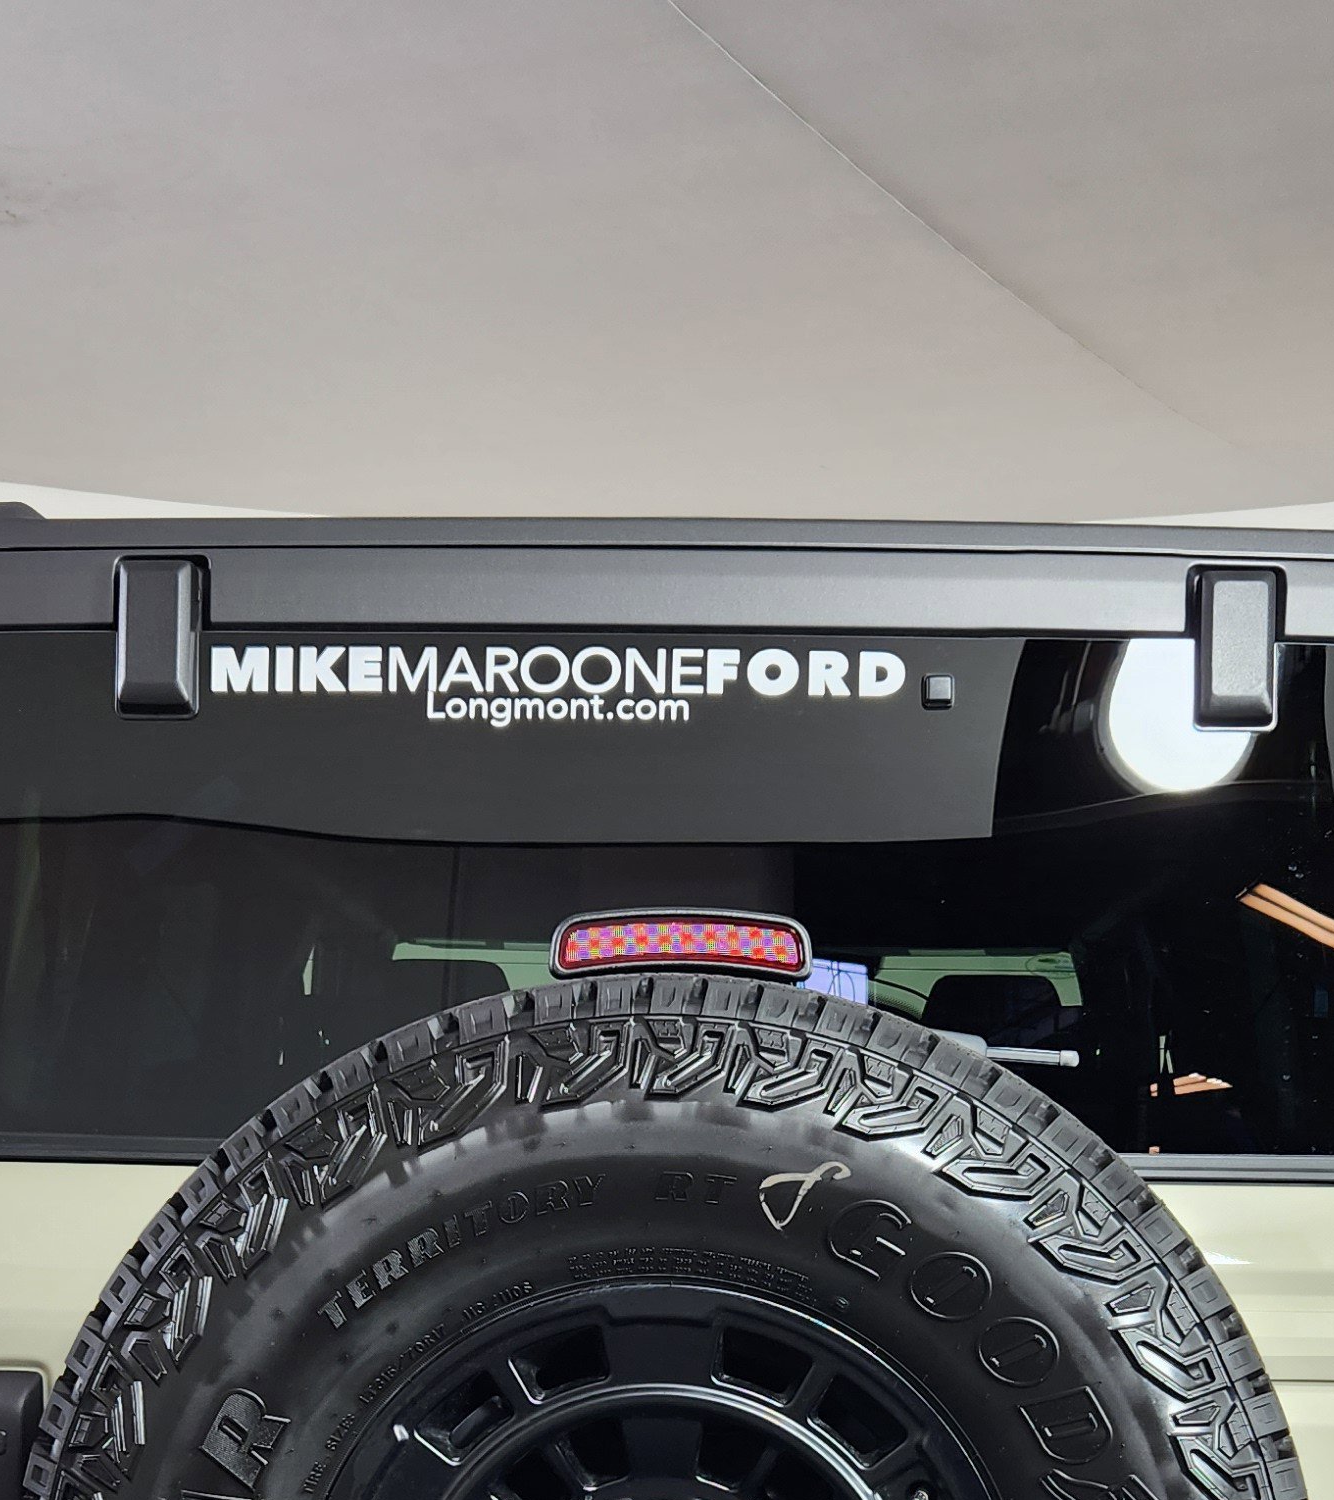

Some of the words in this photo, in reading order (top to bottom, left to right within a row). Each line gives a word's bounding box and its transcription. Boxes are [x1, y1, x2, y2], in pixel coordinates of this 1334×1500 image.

[426, 690, 689, 727] Longmont.com
[317, 1171, 607, 1331] TERRITORY
[655, 1171, 736, 1205] RT
